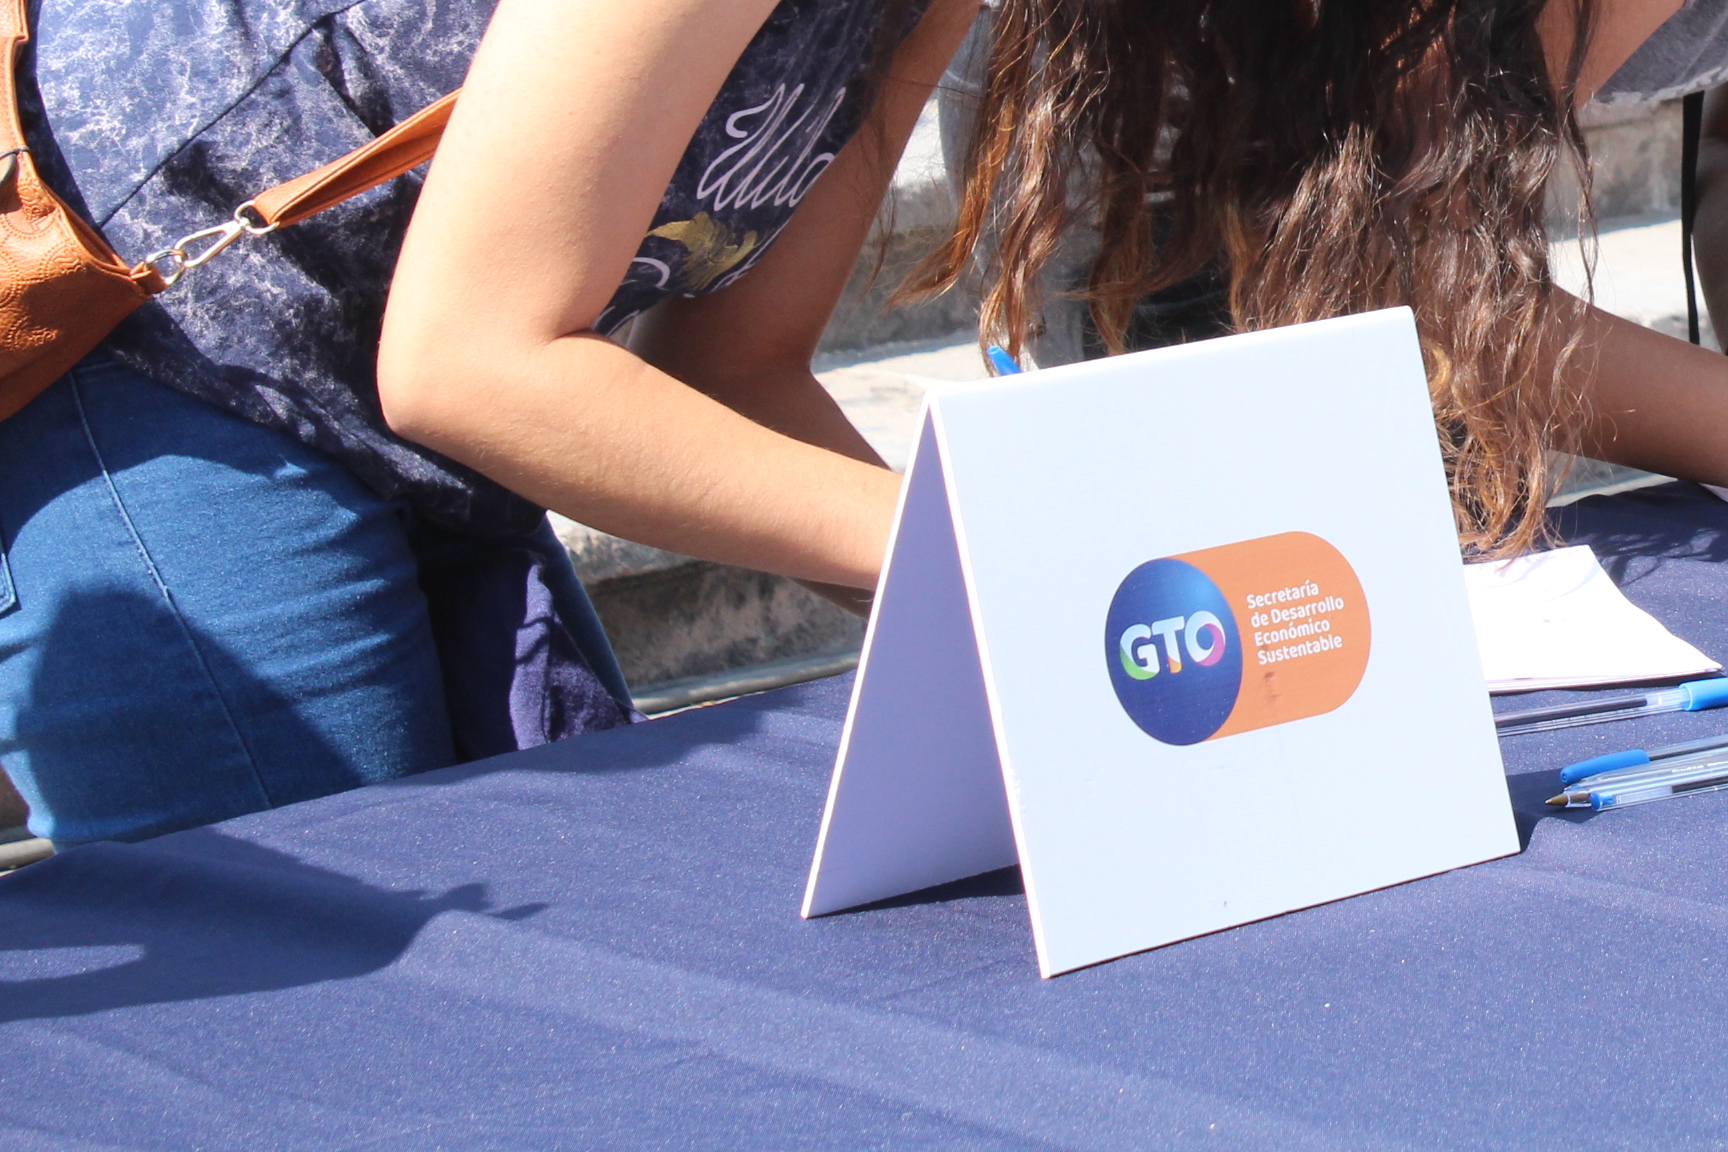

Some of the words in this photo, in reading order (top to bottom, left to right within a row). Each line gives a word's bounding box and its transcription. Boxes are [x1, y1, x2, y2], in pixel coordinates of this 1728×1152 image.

[1246, 580, 1319, 609] Secretaría
[1251, 612, 1269, 628] de
[1270, 596, 1344, 624] Desarrollo
[1120, 610, 1226, 680] GTO
[1254, 618, 1330, 646] Económico
[1257, 634, 1343, 665] Sustentable
